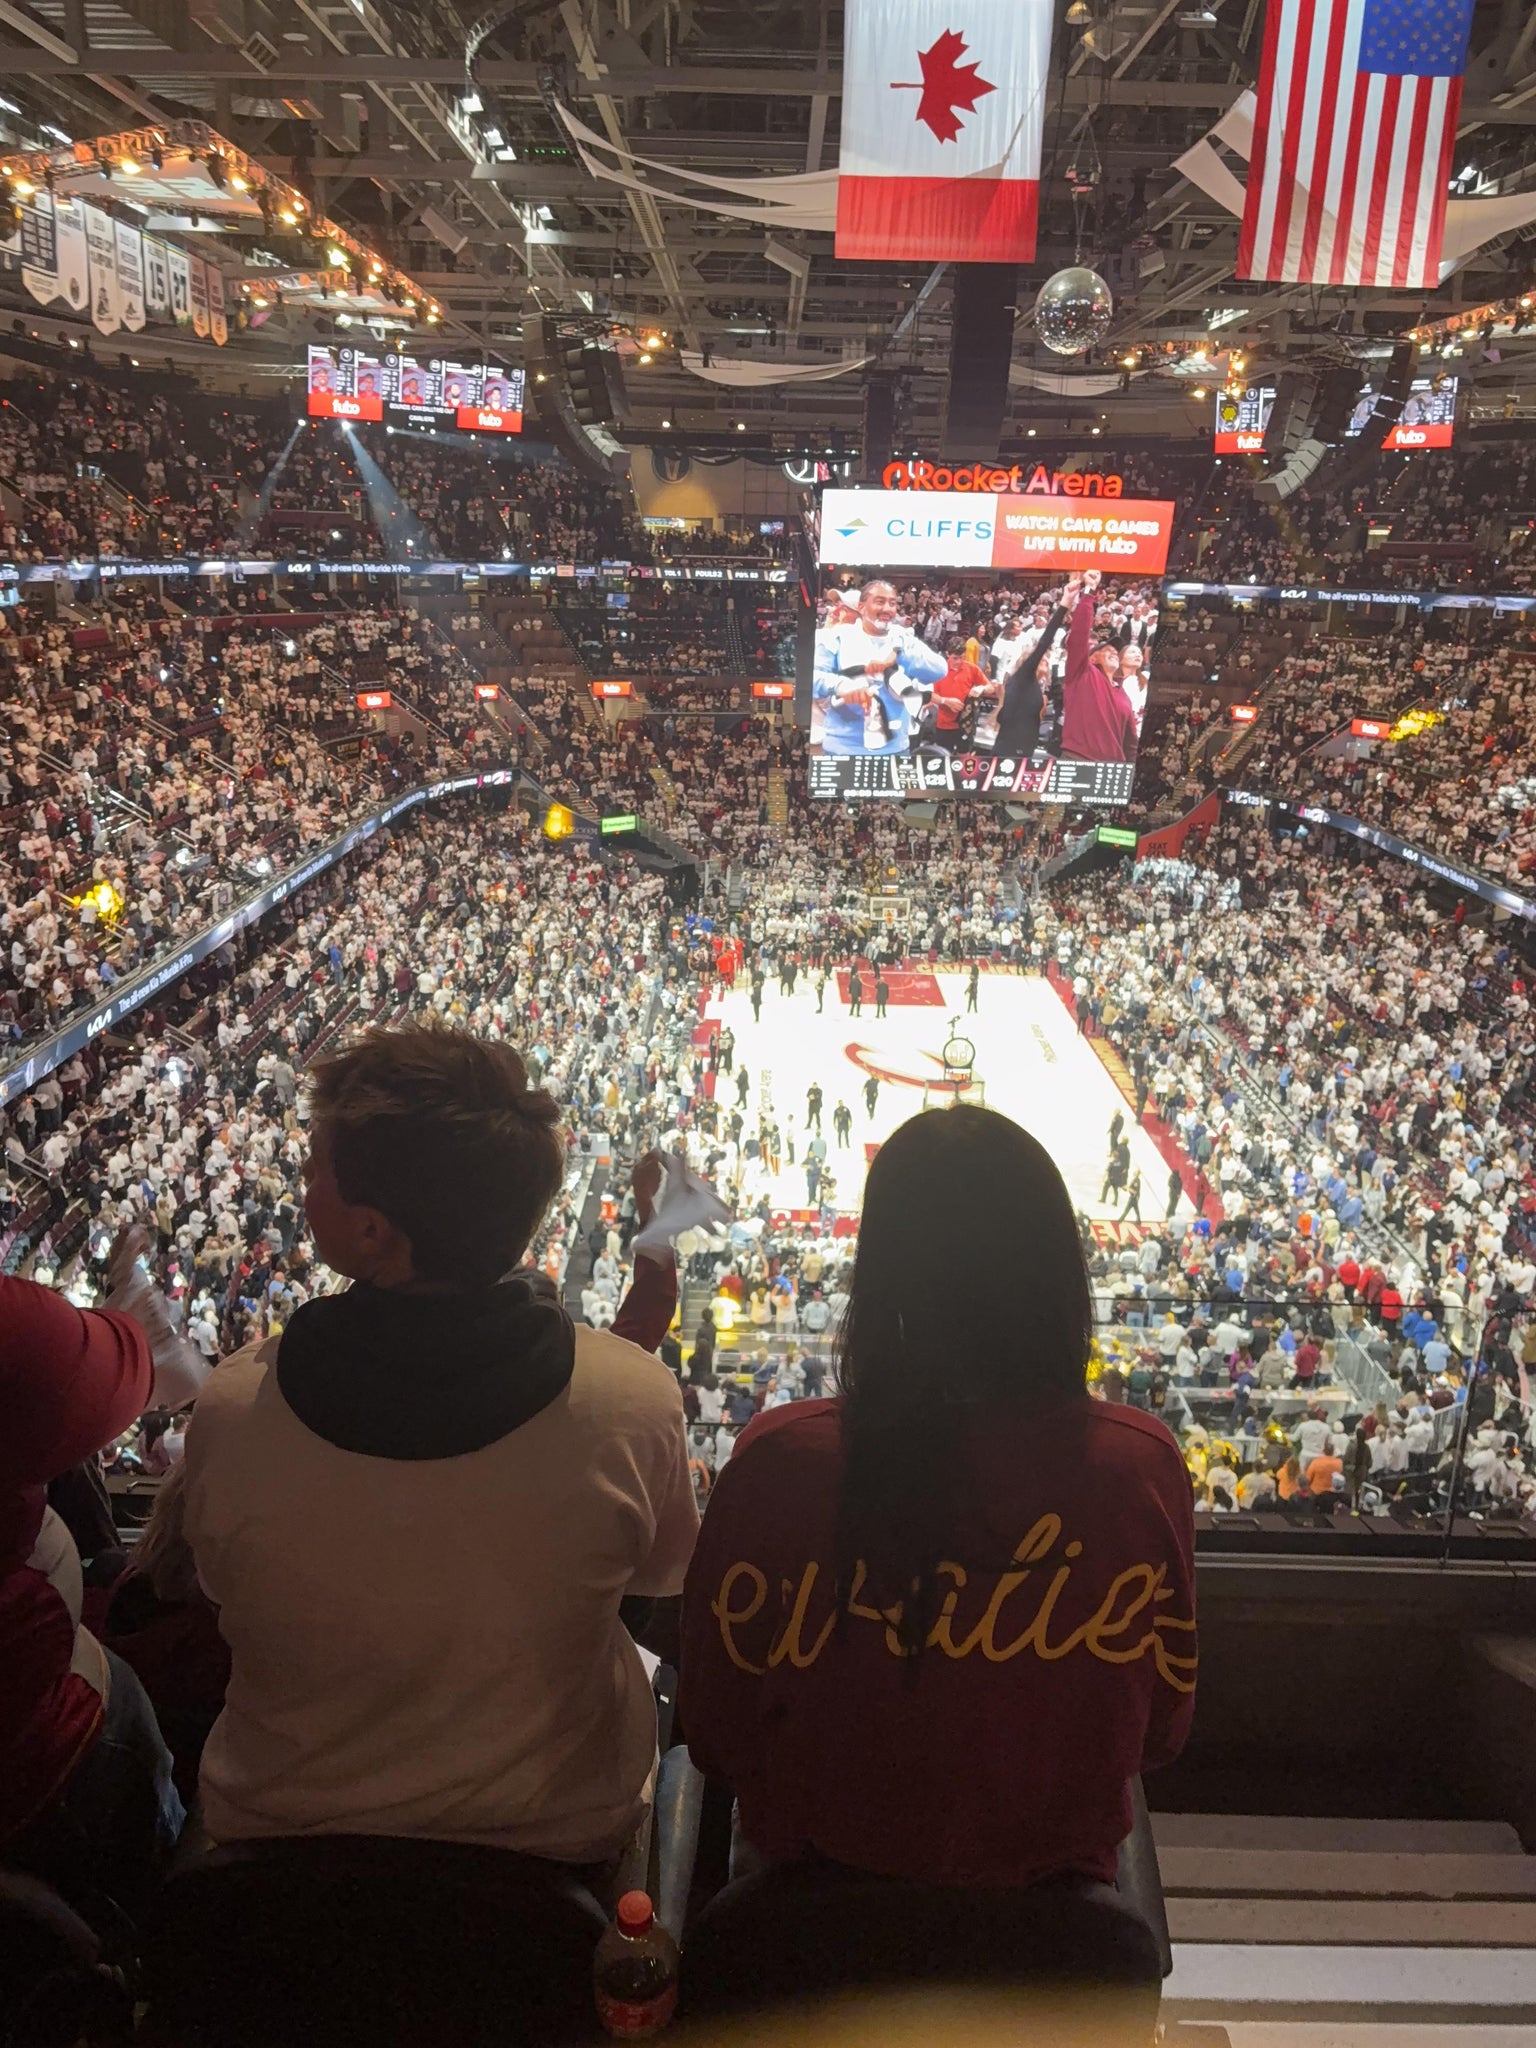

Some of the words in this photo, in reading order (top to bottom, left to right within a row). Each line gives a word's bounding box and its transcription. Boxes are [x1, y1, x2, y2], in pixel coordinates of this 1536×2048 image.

[149, 261, 164, 302] 15
[332, 399, 360, 415] fubo
[478, 412, 502, 427] fubo
[1396, 430, 1426, 445] fubo
[913, 464, 1023, 493] Rocket
[1026, 466, 1123, 498] Arena
[886, 519, 992, 540] CLIFFS
[1005, 515, 1058, 532] WATCH
[1061, 516, 1103, 534] CAVS
[1105, 518, 1160, 536] GAMES
[1023, 536, 1056, 551] LIVE
[1058, 537, 1096, 553] WITH
[1098, 535, 1138, 555] fubo
[1318, 590, 1331, 600] The
[924, 773, 946, 786] 125
[992, 775, 1014, 788] 120
